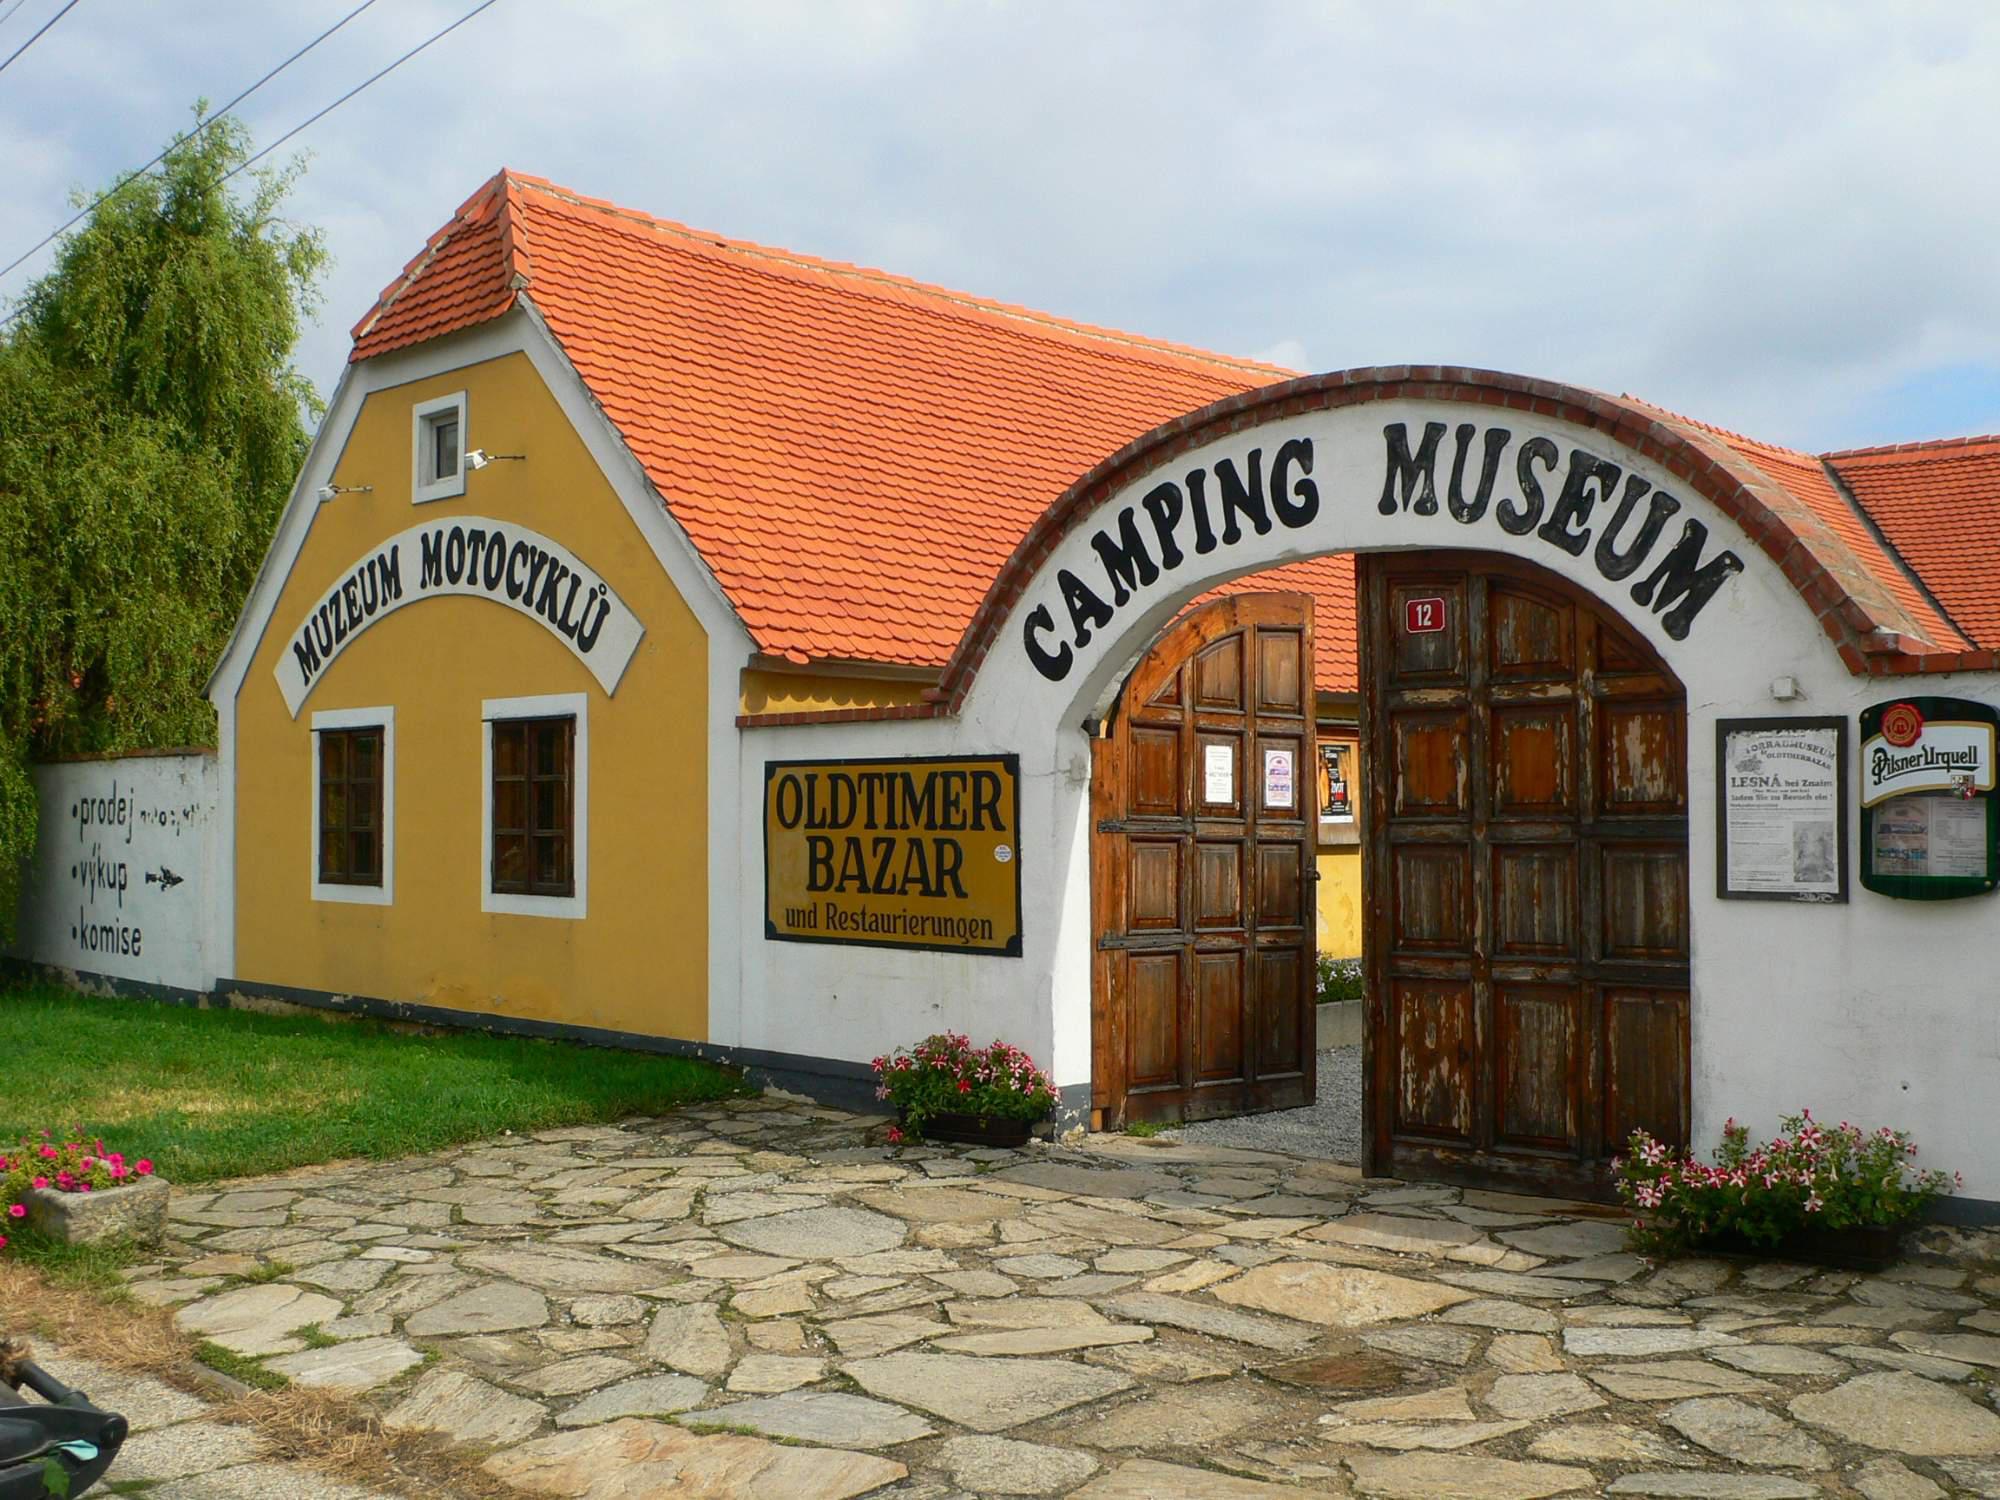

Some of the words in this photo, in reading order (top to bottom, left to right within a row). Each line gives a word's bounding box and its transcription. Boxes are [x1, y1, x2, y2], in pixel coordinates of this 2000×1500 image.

[1022, 437, 1320, 682] CAMPING
[1378, 421, 1746, 641] MUSEUM
[292, 544, 403, 687] MUZEUM
[419, 525, 611, 654] MOTOCYKLŮ
[1416, 603, 1432, 627] 12
[1730, 773, 1782, 788] LESNÁ
[1871, 747, 1923, 786] Pilsner
[1921, 743, 1978, 774] Urquell
[79, 779, 134, 844] prodej
[776, 770, 1006, 831] OLDTIMER
[79, 842, 128, 908] výkup
[806, 835, 968, 898] BAZAR
[79, 905, 142, 957] komise
[785, 902, 818, 929] und
[825, 903, 993, 944] Restaurierungen
